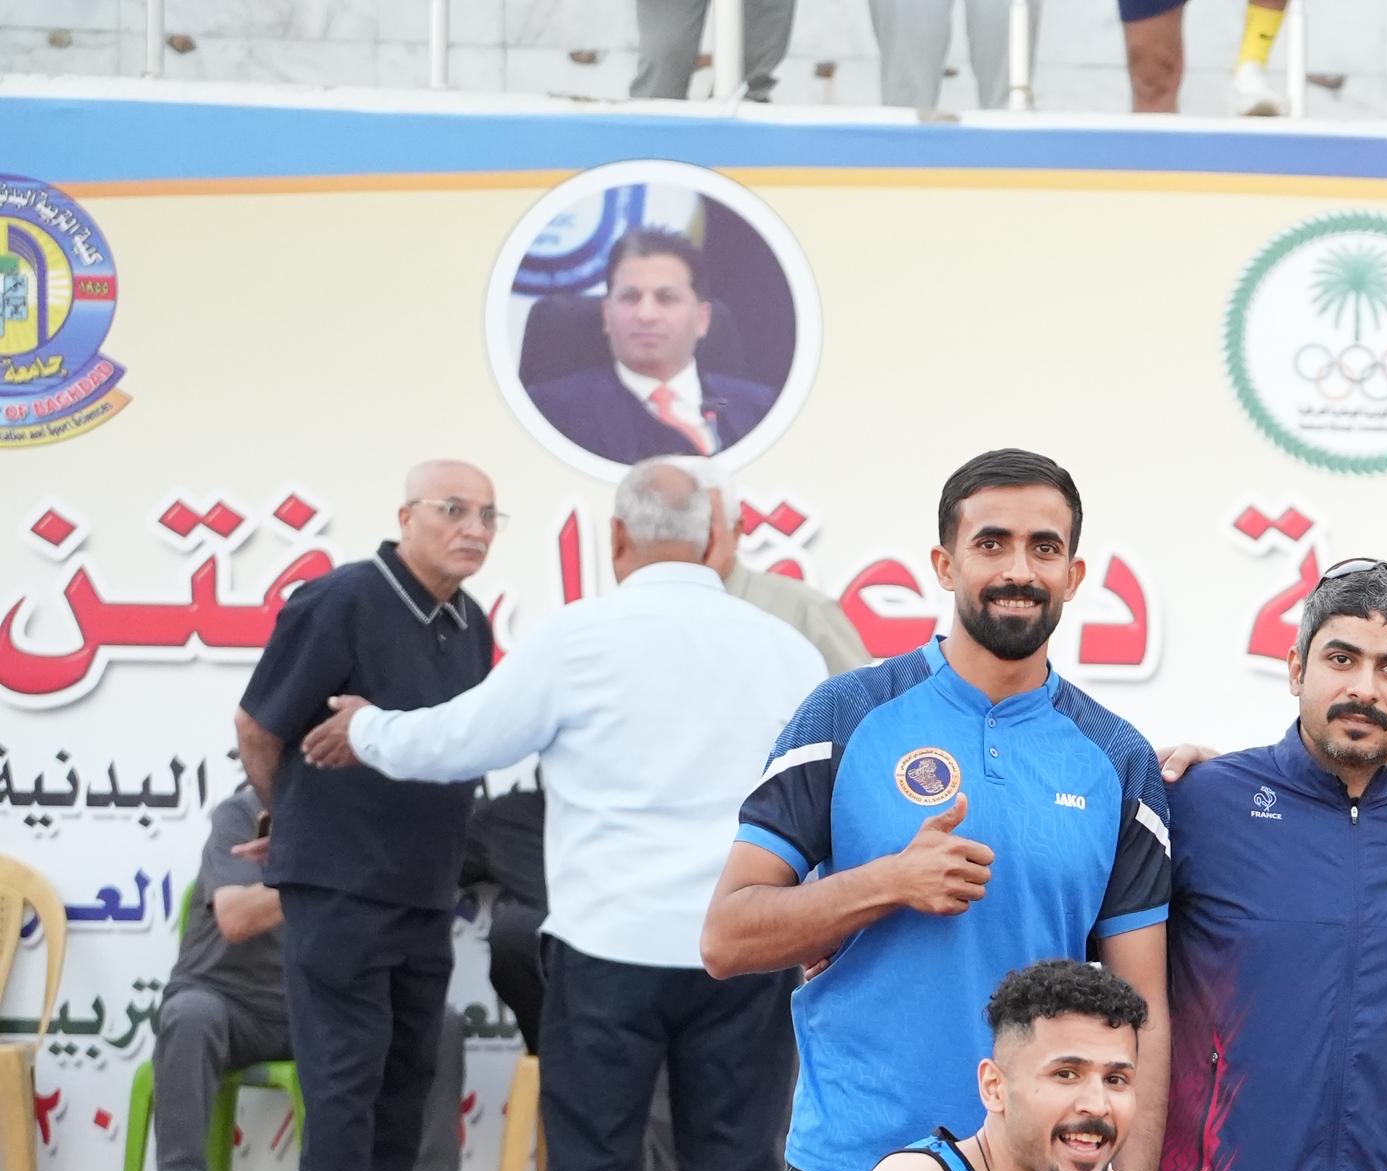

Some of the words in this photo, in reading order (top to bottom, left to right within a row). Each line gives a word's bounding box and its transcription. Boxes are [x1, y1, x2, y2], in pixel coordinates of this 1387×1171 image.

[4, 402, 28, 420] OF
[32, 359, 114, 417] BAGHDAD
[0, 493, 335, 695] فتن
[1054, 792, 1086, 810] JAKO
[1250, 810, 1283, 820] FRANCE
